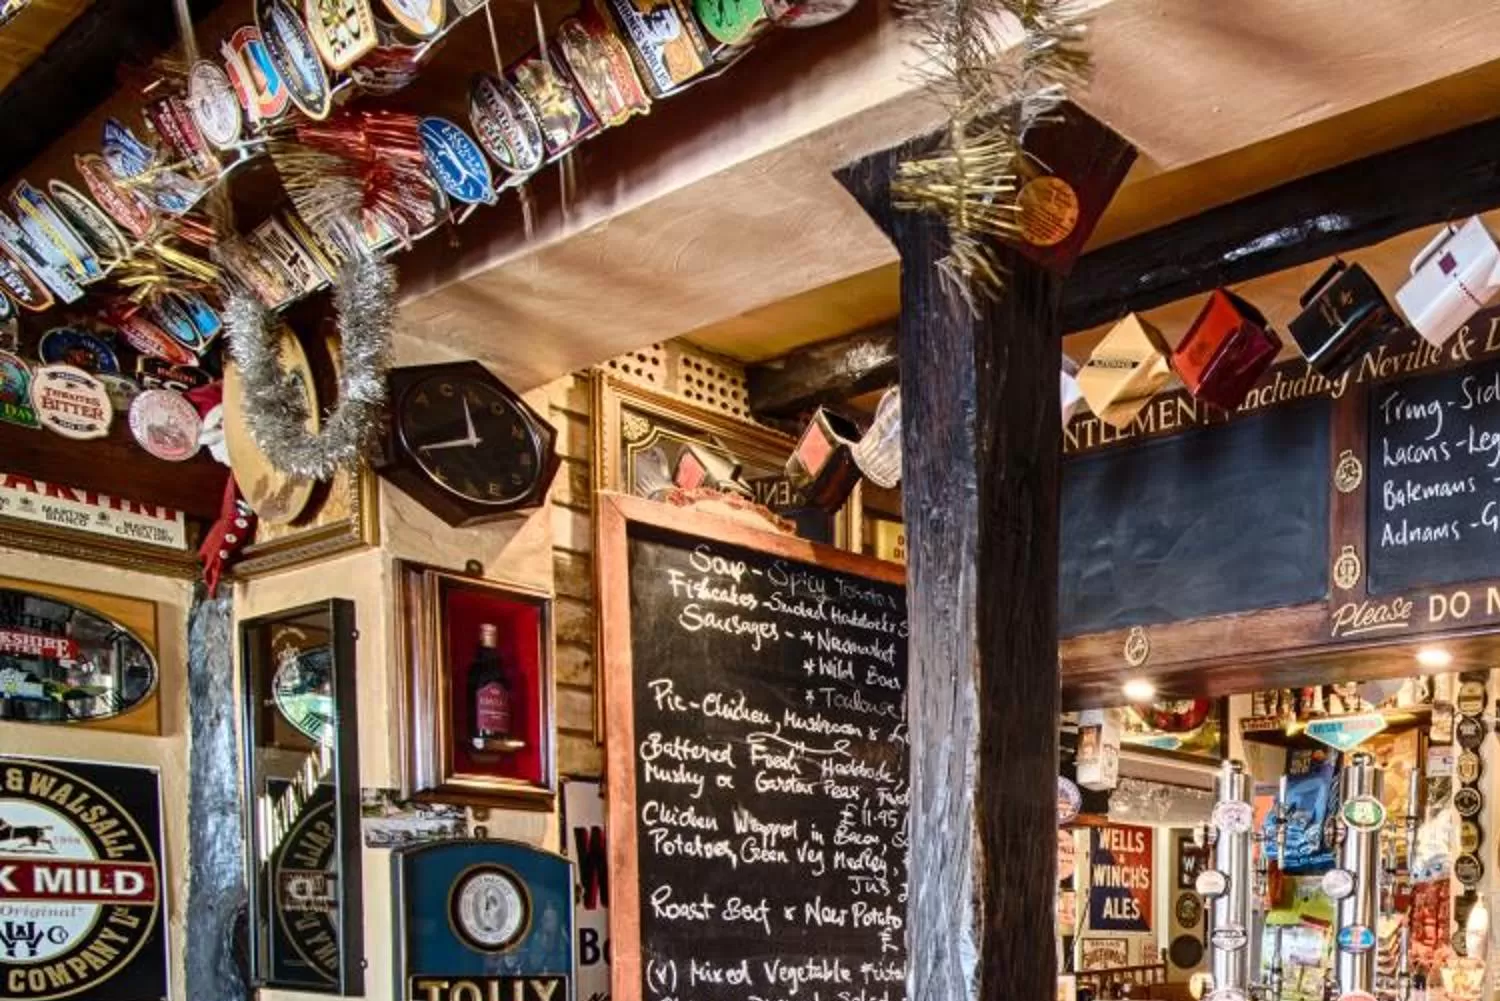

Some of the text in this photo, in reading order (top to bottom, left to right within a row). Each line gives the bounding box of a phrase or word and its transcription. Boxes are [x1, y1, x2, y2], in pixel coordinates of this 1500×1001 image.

[1450, 326, 1478, 360] &
[41, 394, 105, 422] BITTER
[1329, 596, 1414, 641] Please
[1427, 588, 1472, 623] DO
[29, 771, 136, 859] WALSALL
[1097, 827, 1146, 854] WELLS
[32, 866, 146, 897] MILD
[1091, 863, 1151, 890] WINCH'S
[650, 884, 716, 920] Roast
[1102, 895, 1142, 920] ALES
[8, 928, 130, 993] COMPANY
[763, 957, 853, 996] Vegetable
